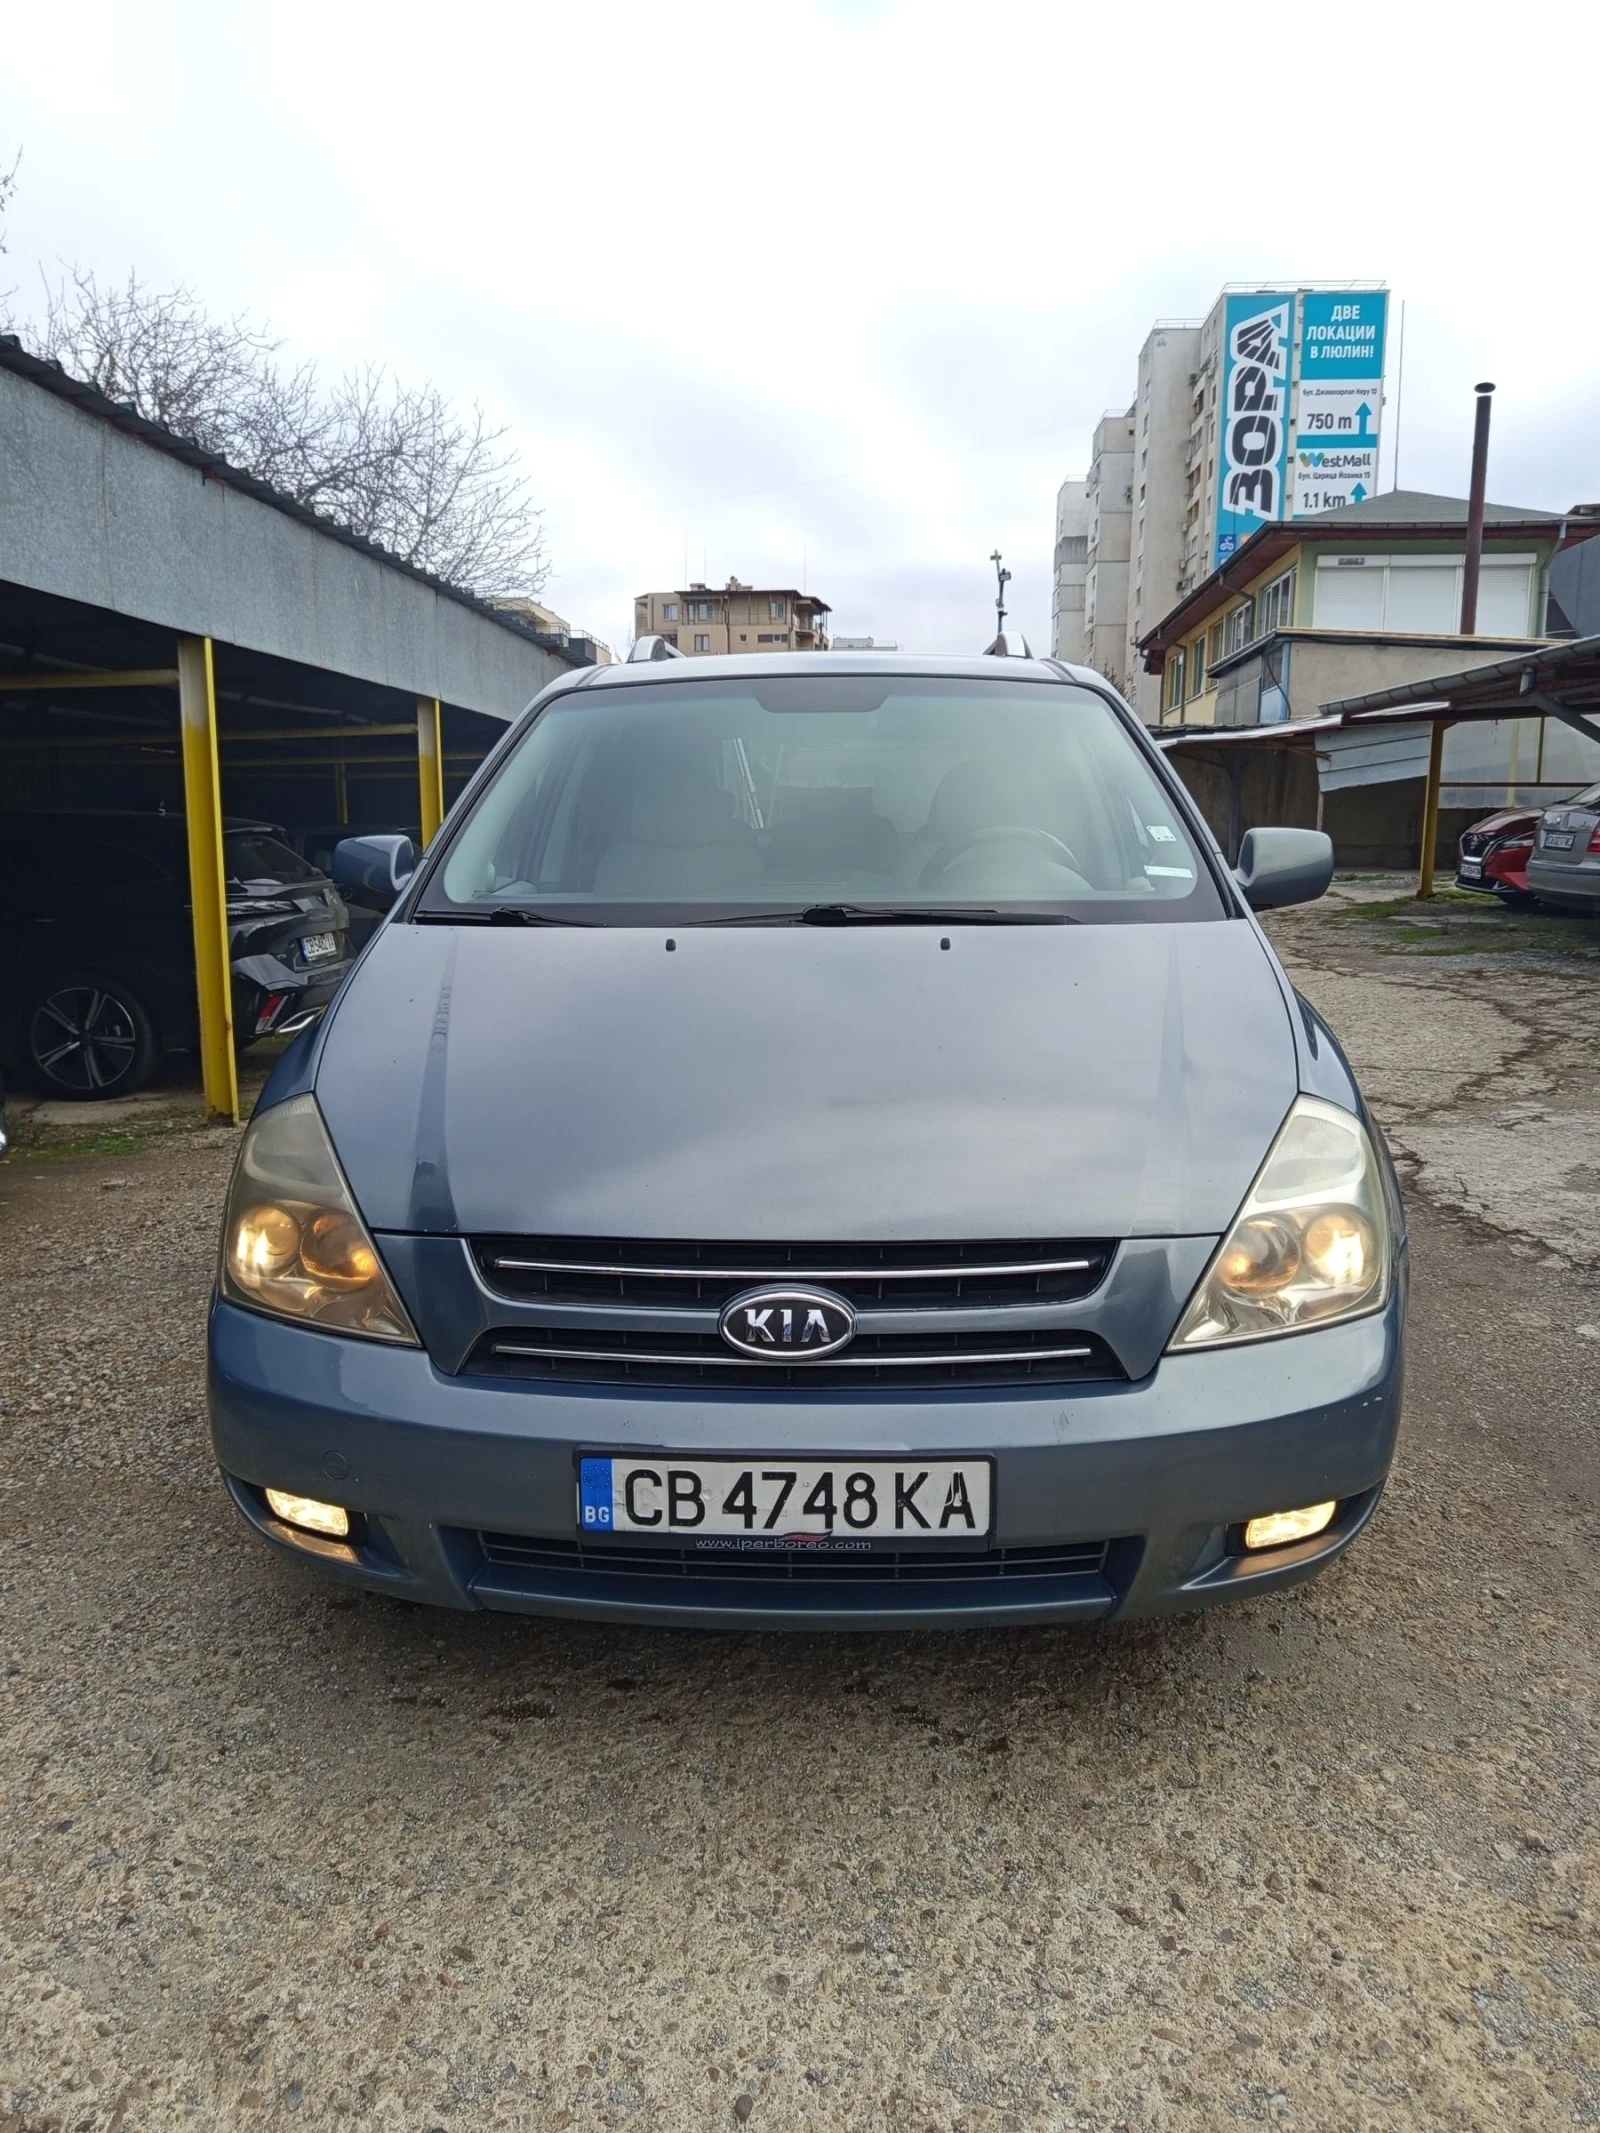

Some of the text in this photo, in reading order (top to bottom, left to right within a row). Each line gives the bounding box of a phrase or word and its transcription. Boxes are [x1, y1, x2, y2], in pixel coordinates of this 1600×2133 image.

[1331, 305, 1360, 322] ДВЕ
[1306, 325, 1376, 342] ЛОКАЦИИ
[1310, 345, 1374, 358] В ЛЮЛИН!
[1307, 413, 1352, 429] 750 m
[1299, 452, 1371, 468] WestMall
[1303, 492, 1346, 508] 1.1 km
[744, 1309, 831, 1342] KIA
[625, 1469, 976, 1529] CB 4748 KA
[584, 1506, 610, 1524] BG
[695, 1537, 871, 1550] www.iperboreo.com
